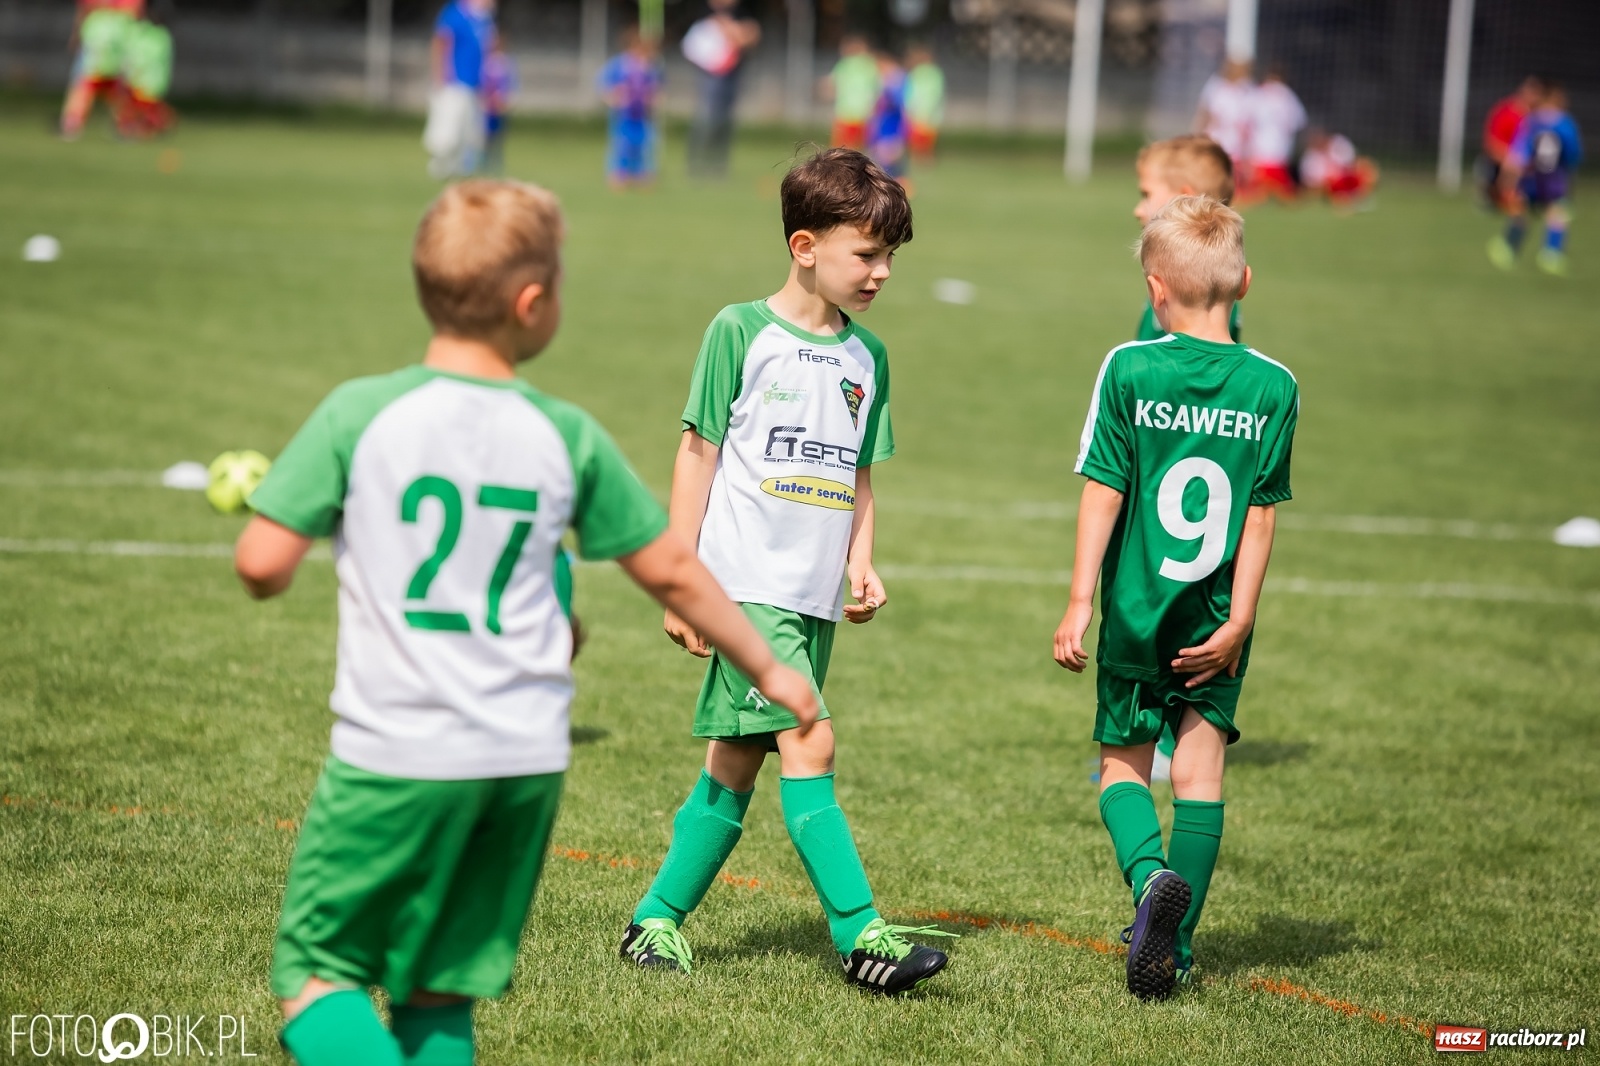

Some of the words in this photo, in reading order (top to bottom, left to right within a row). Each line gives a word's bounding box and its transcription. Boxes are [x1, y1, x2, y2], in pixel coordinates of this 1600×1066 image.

[1134, 398, 1268, 442] KSAWERY
[775, 480, 813, 495] inter
[816, 490, 855, 505] service
[1157, 456, 1233, 583] 9
[401, 475, 538, 636] 27
